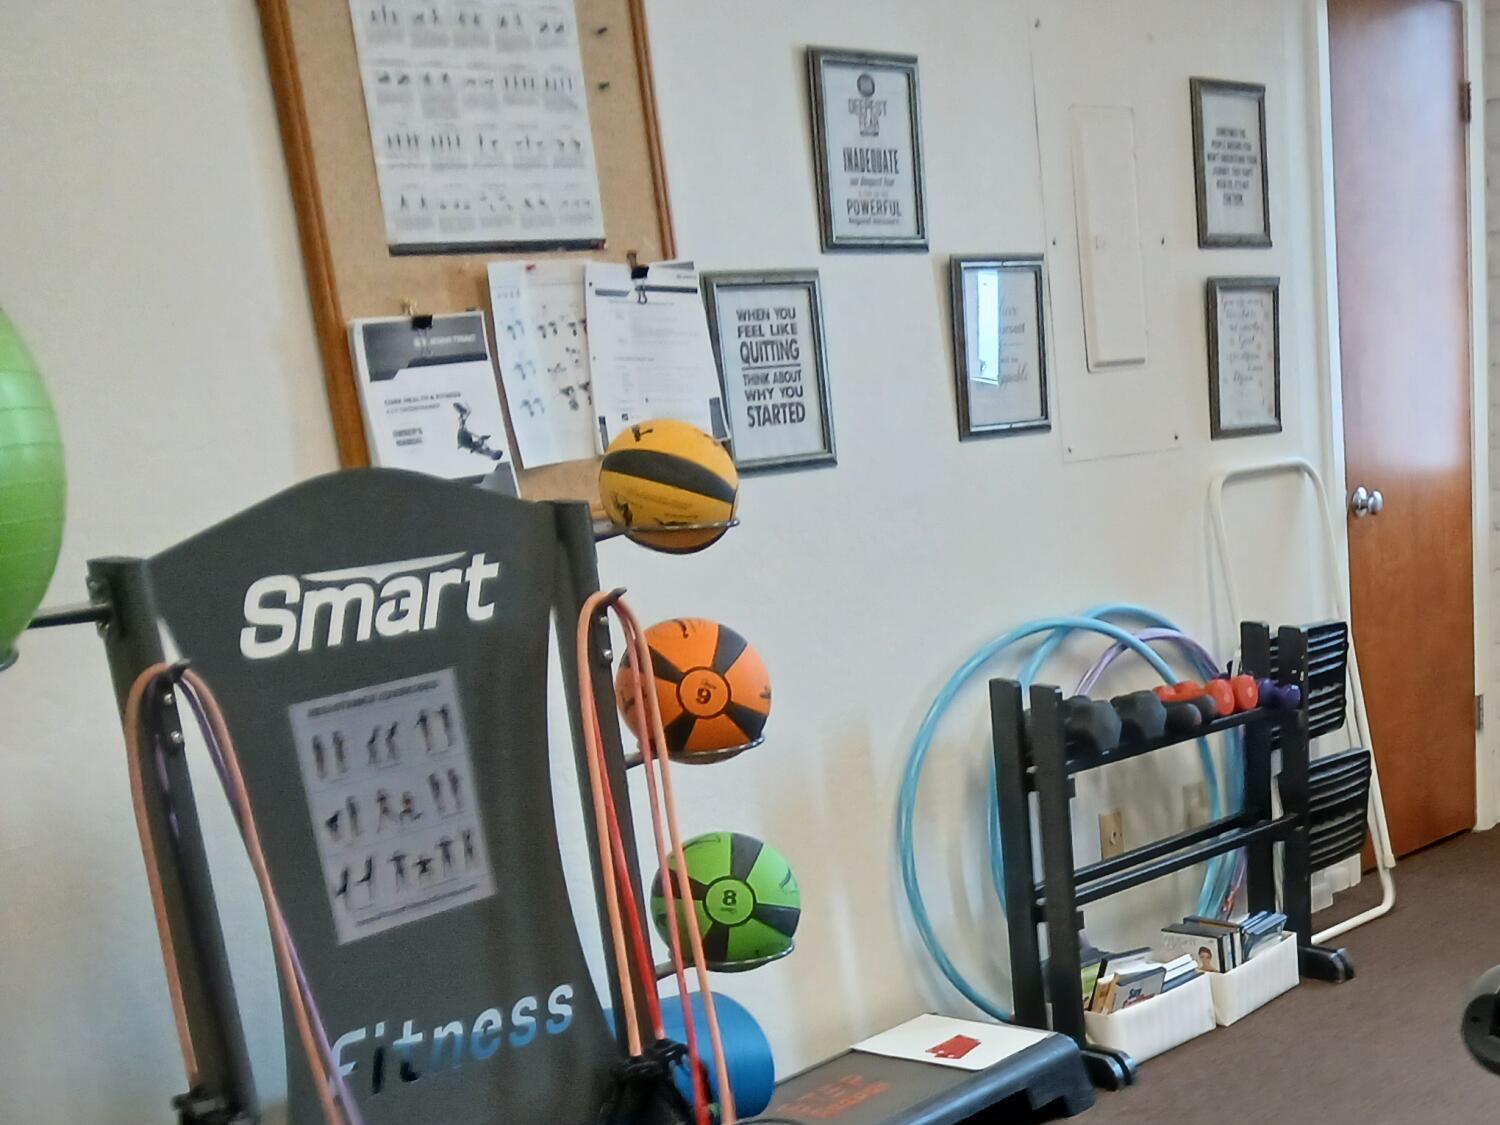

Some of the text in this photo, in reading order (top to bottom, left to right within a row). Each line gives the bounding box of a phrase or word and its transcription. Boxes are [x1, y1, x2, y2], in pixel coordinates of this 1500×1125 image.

[842, 147, 900, 174] INADEQUATE
[847, 199, 902, 217] POWERFUL
[736, 306, 797, 322] WHEN YOU
[737, 322, 799, 339] FEEL LIKE
[739, 338, 800, 367] QUITTING
[743, 368, 802, 387] THINK ABOUT
[745, 384, 804, 401] WHY YOU
[747, 402, 806, 428] STARTED
[239, 553, 500, 660] Smart
[722, 889, 738, 906] 8
[331, 984, 575, 1095] Fitness
